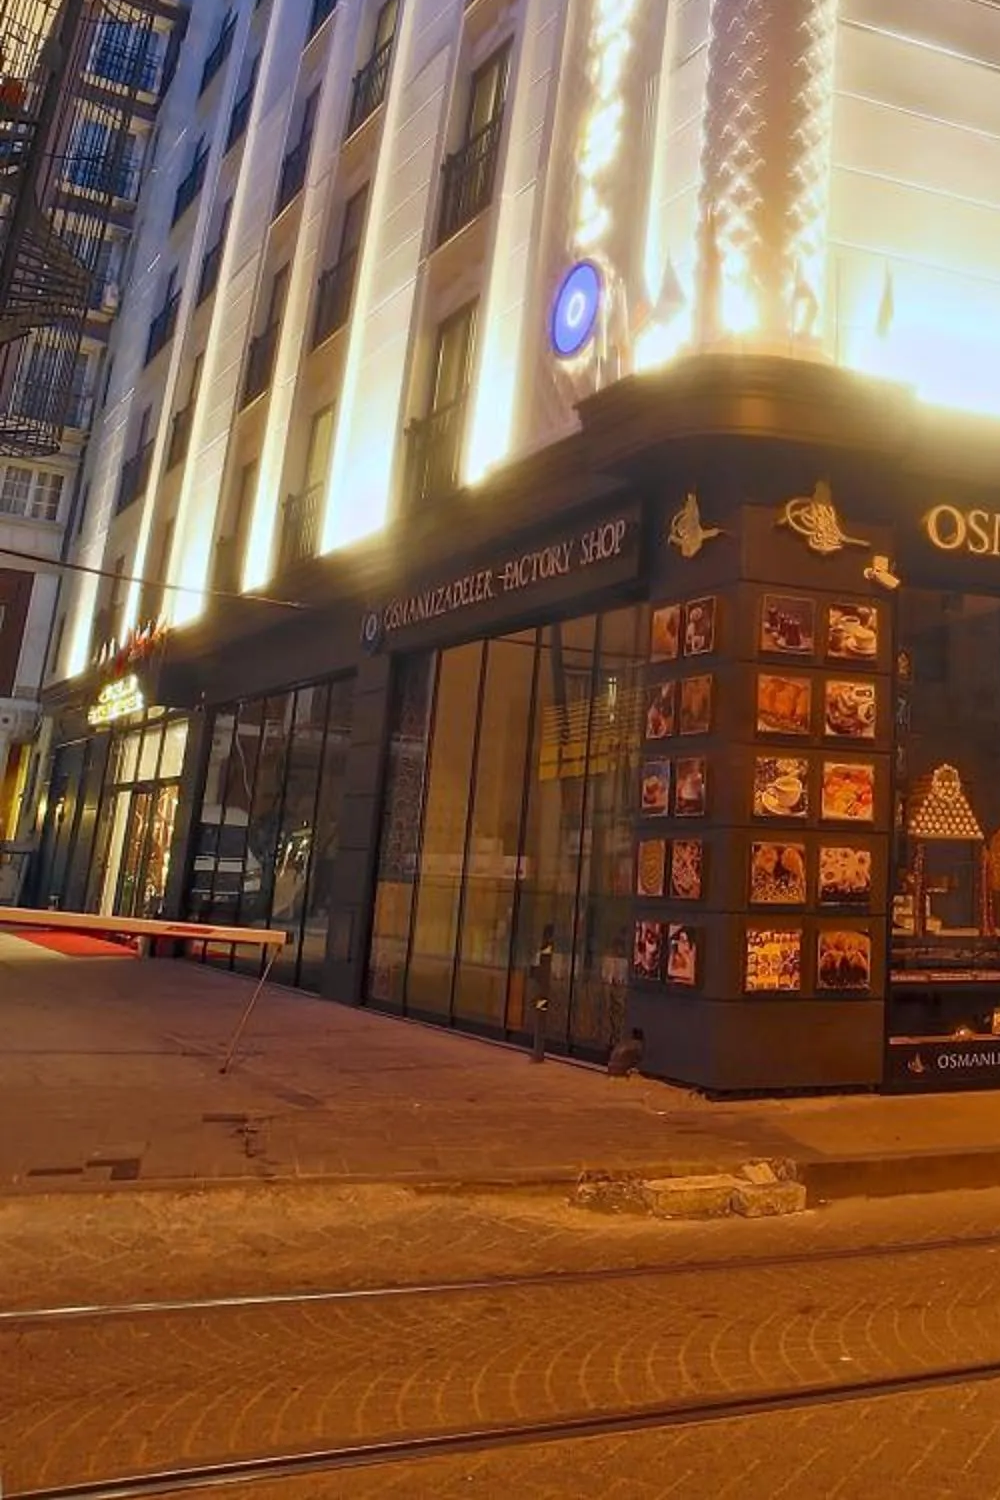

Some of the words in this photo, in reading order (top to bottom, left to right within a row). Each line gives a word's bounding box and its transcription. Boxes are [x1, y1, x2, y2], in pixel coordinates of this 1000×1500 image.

[383, 569, 495, 631] OSMANLIZADELER
[503, 538, 574, 591] FACTORY
[580, 519, 626, 565] SHOP
